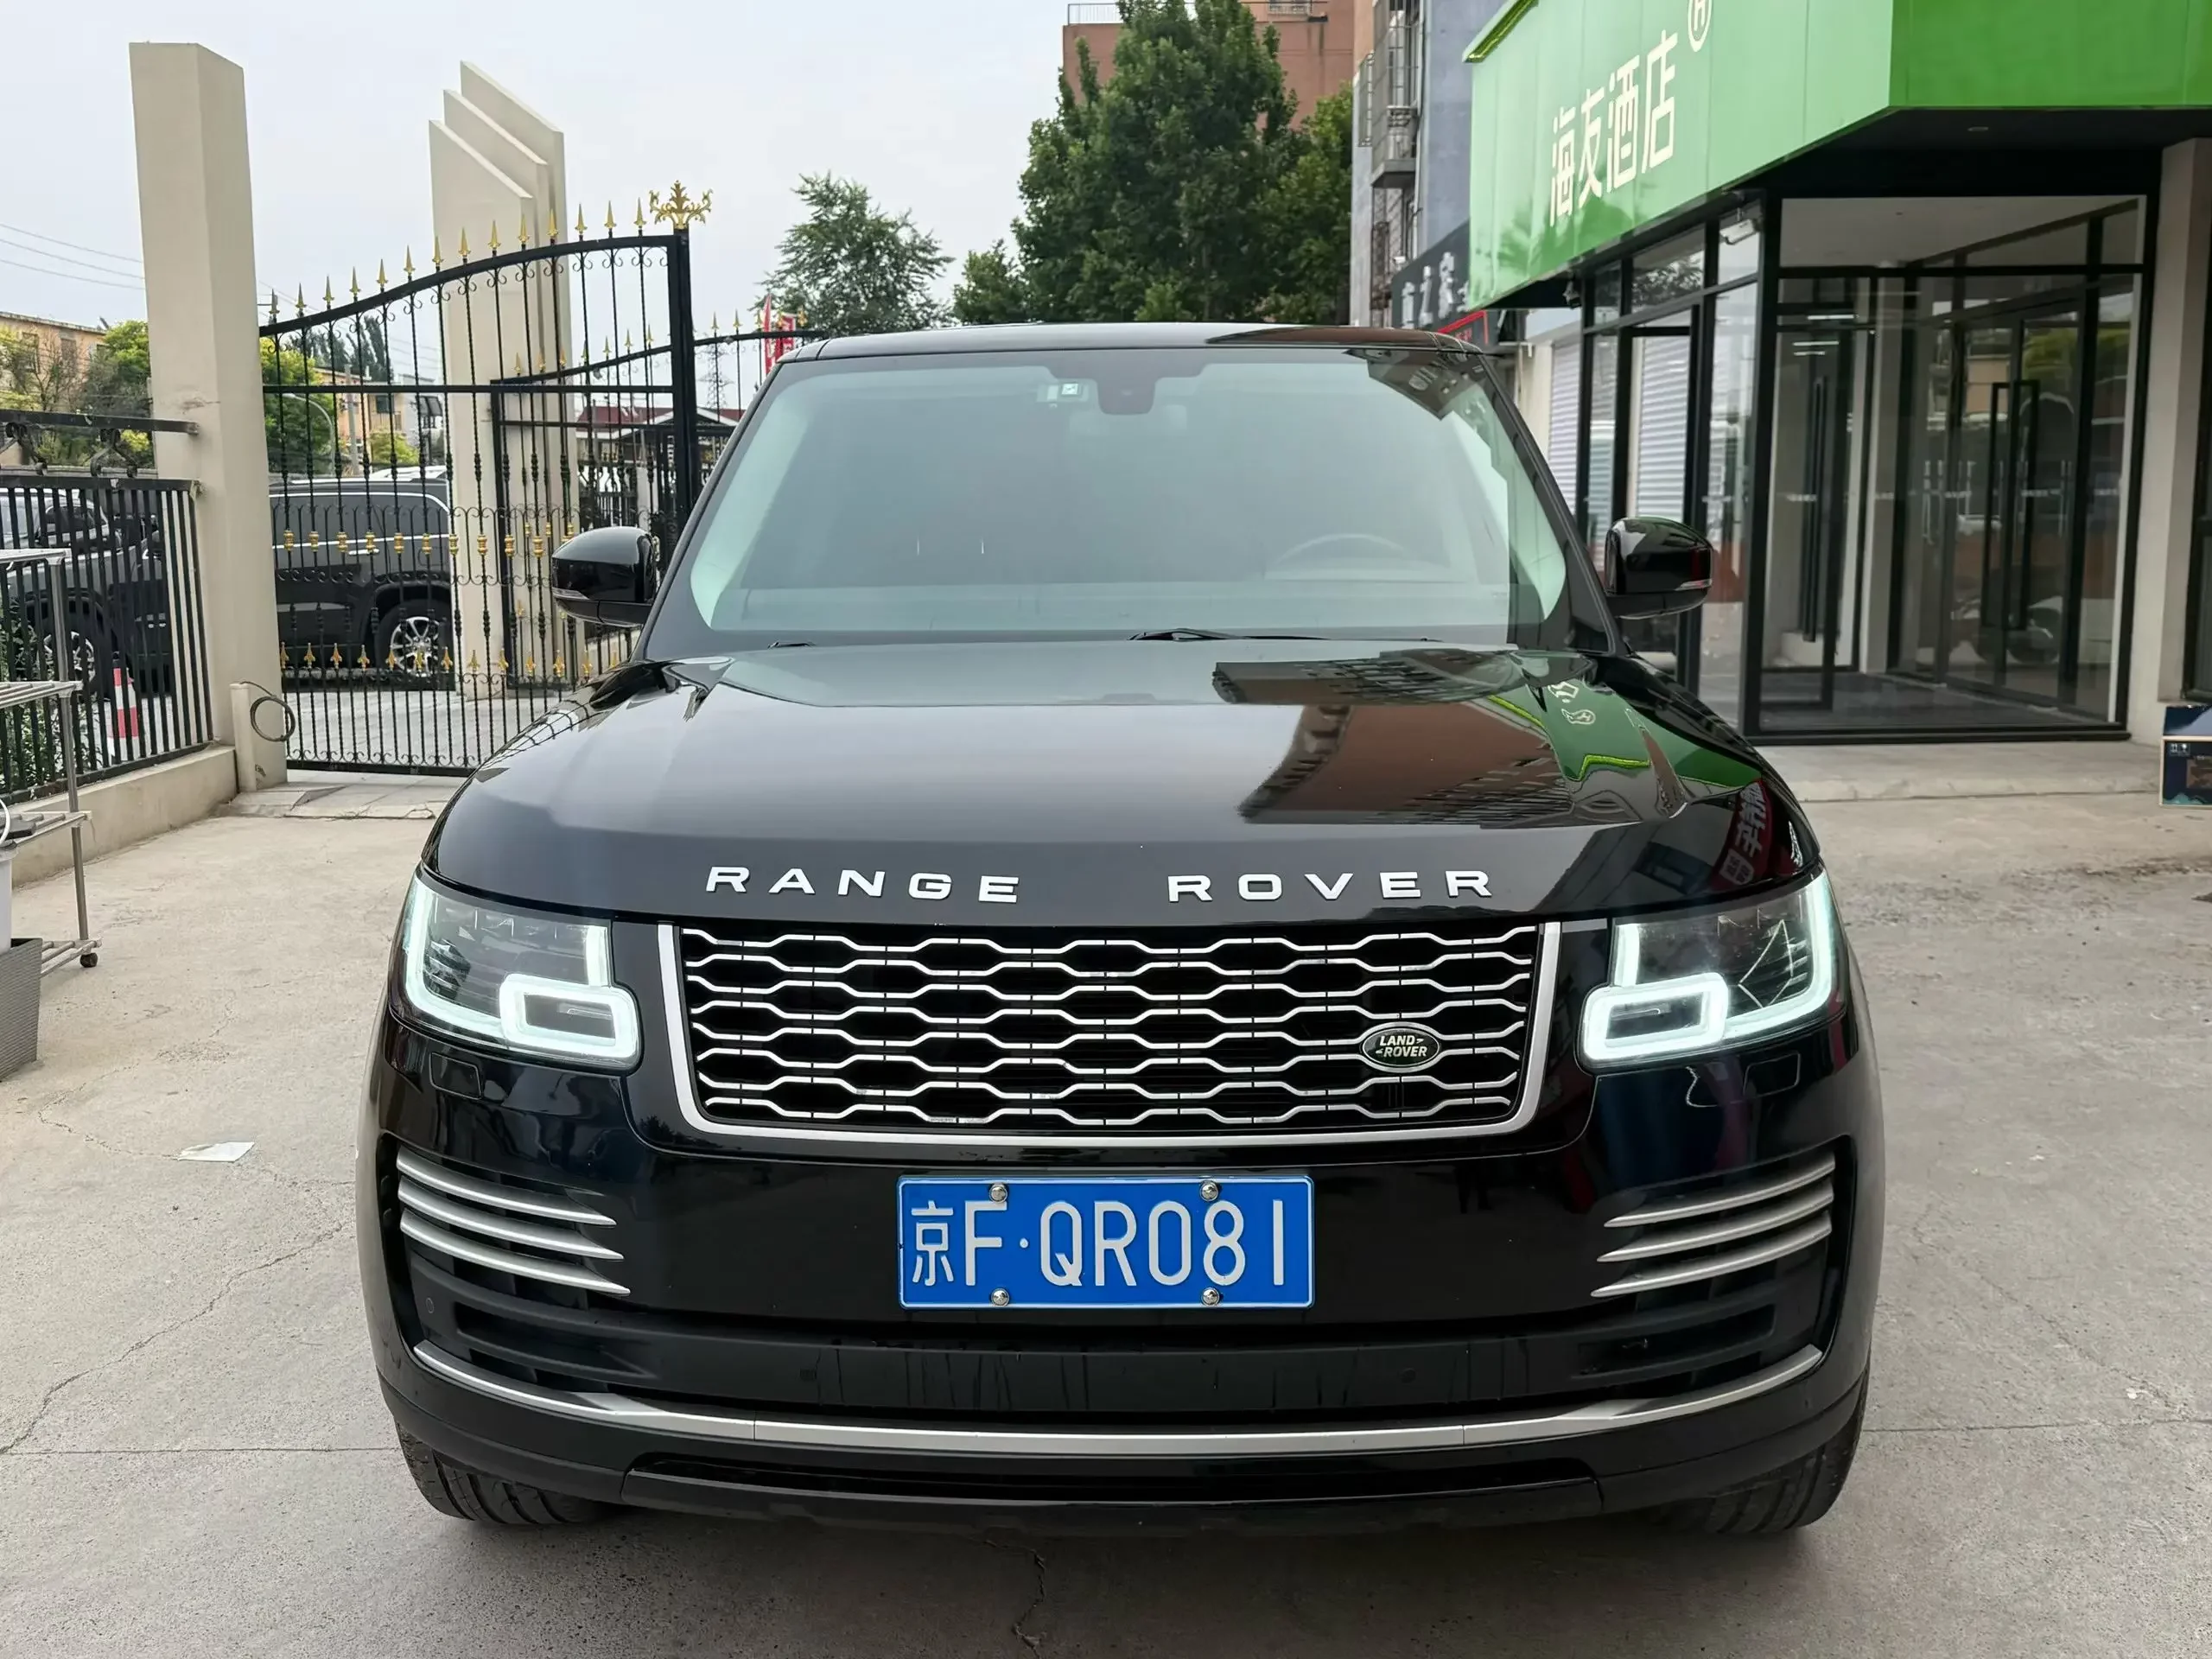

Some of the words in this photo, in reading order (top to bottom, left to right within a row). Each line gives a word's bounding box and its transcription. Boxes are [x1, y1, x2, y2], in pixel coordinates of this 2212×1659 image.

[1550, 29, 1679, 227] 海友酒店
[705, 866, 1020, 904] RANGE
[1167, 870, 1492, 902] ROVER
[1379, 1035, 1416, 1046] LAND
[1382, 1046, 1427, 1058] ROVER
